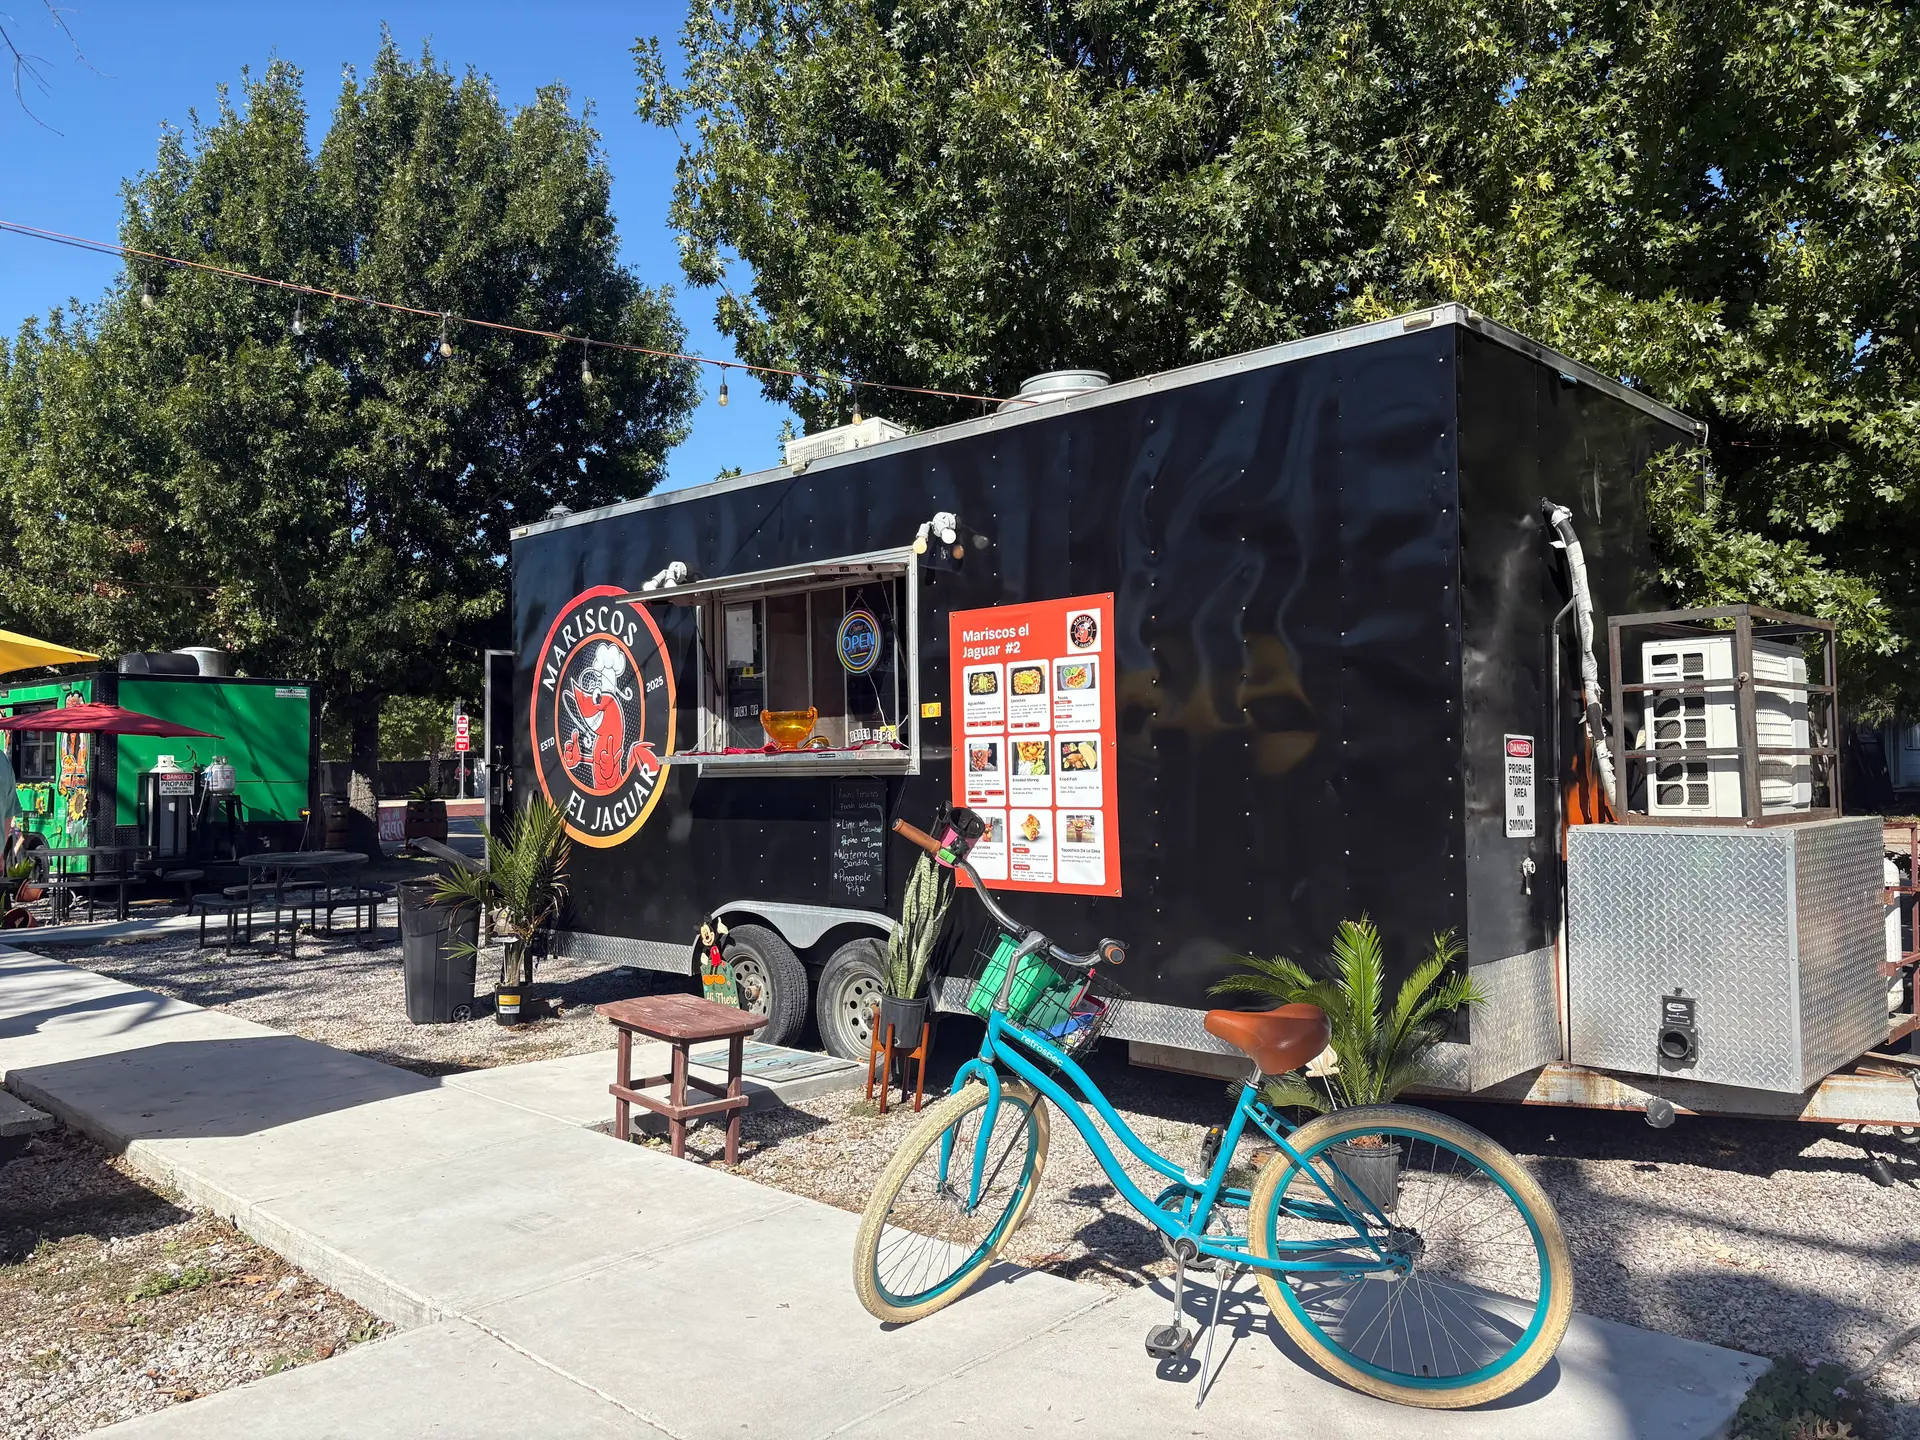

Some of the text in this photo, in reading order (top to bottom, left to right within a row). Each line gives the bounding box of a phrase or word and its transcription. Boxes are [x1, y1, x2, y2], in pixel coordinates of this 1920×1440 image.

[1073, 616, 1093, 626] MARISCOS
[962, 623, 1029, 642] Mariscos el
[842, 631, 875, 651] OPEN
[543, 606, 638, 692] MARISCOS
[962, 641, 1021, 659] Jaguar #2
[645, 675, 664, 693] 2025
[750, 704, 759, 716] UP
[850, 728, 871, 742] ORDER
[540, 736, 555, 752] ESTD
[1510, 742, 1530, 753] DANGER
[1508, 763, 1532, 774] PROPANE
[1508, 776, 1532, 786] STORAGE
[567, 762, 658, 831] EL JAGUAR
[1513, 788, 1528, 798] AREA
[1516, 805, 1524, 816] NO
[1509, 819, 1533, 831] SMOKING
[838, 868, 871, 884] Pineapple
[715, 992, 738, 1005] There
[1021, 1034, 1064, 1067] retrospec
